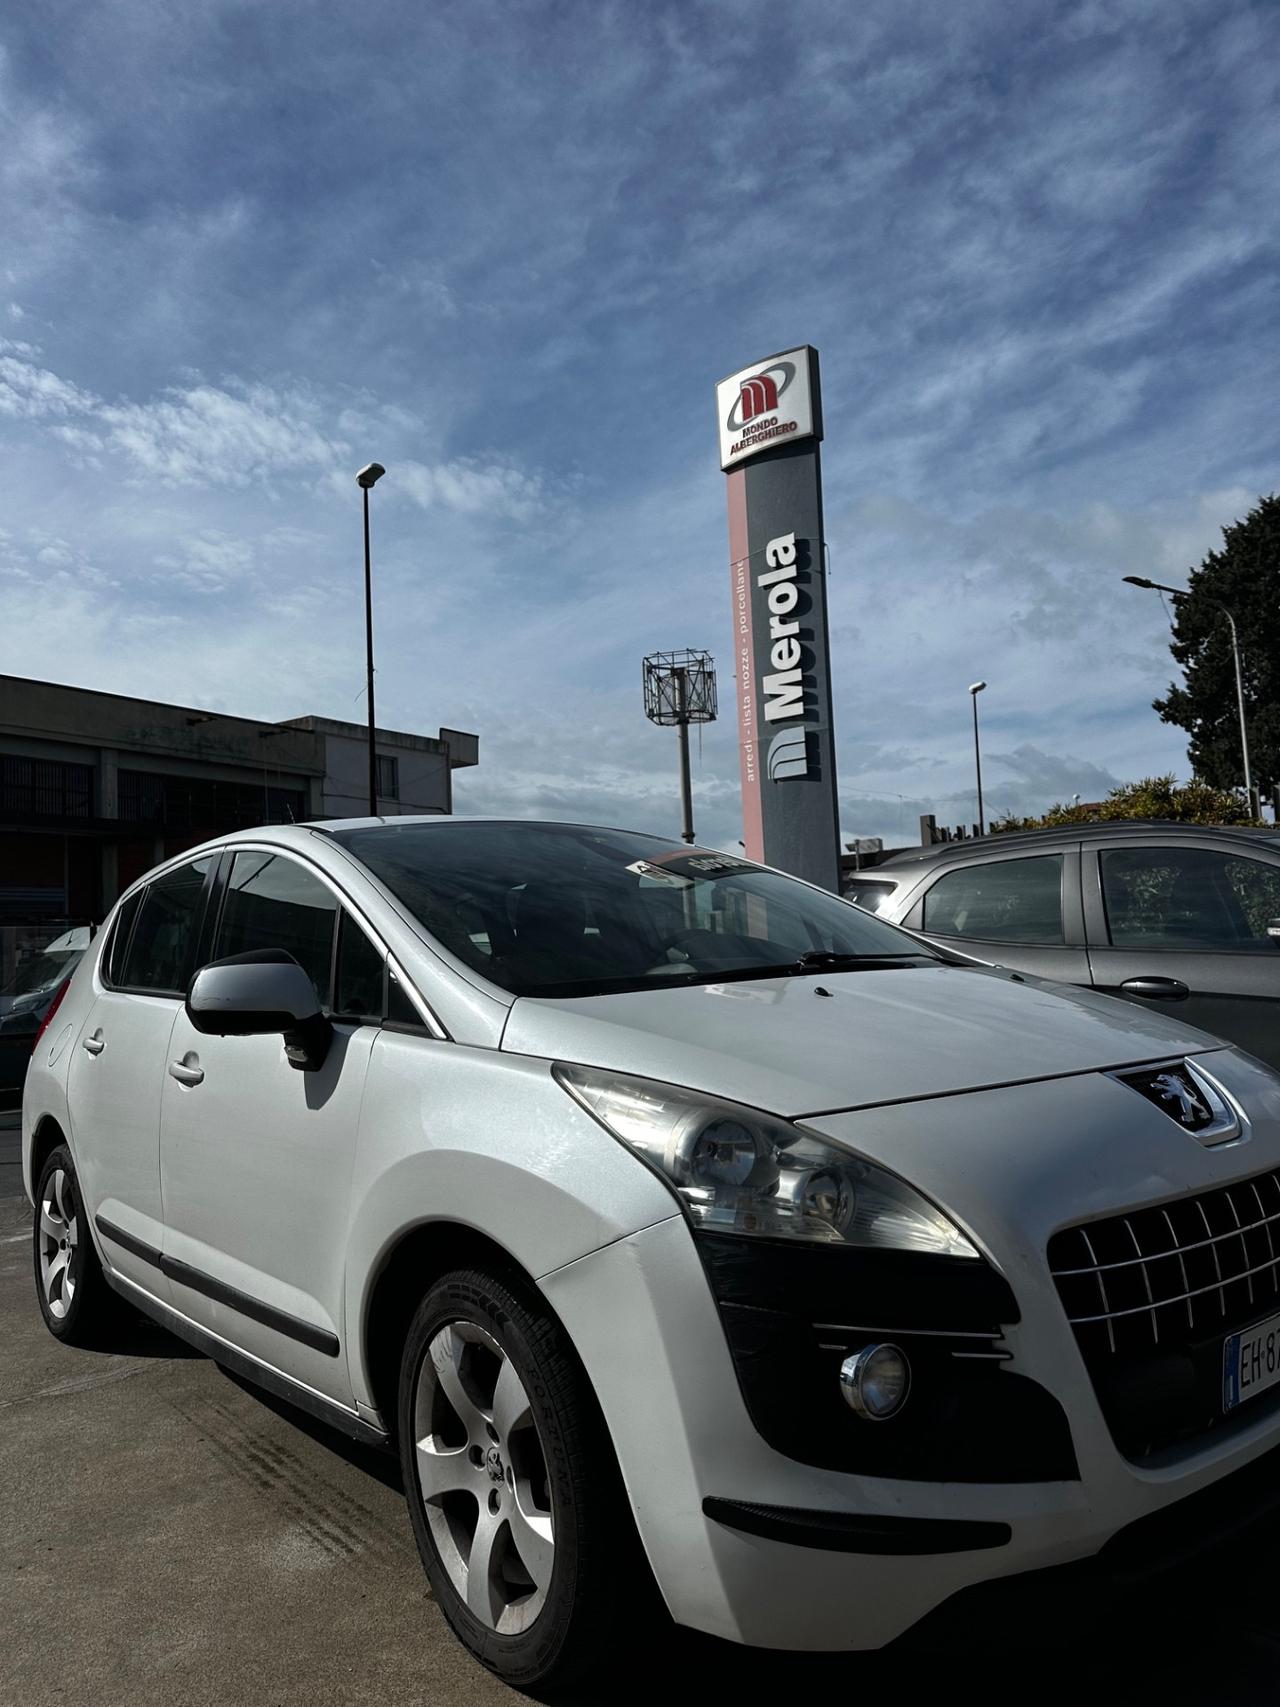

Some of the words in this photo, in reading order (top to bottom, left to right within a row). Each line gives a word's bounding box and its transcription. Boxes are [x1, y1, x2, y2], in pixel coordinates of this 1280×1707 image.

[730, 421, 798, 455] ALBERGHIERO
[742, 416, 778, 438] MONDO
[758, 532, 804, 720] Merola
[741, 648, 751, 689] nozze
[743, 696, 752, 726] lista
[744, 741, 754, 782] arredi
